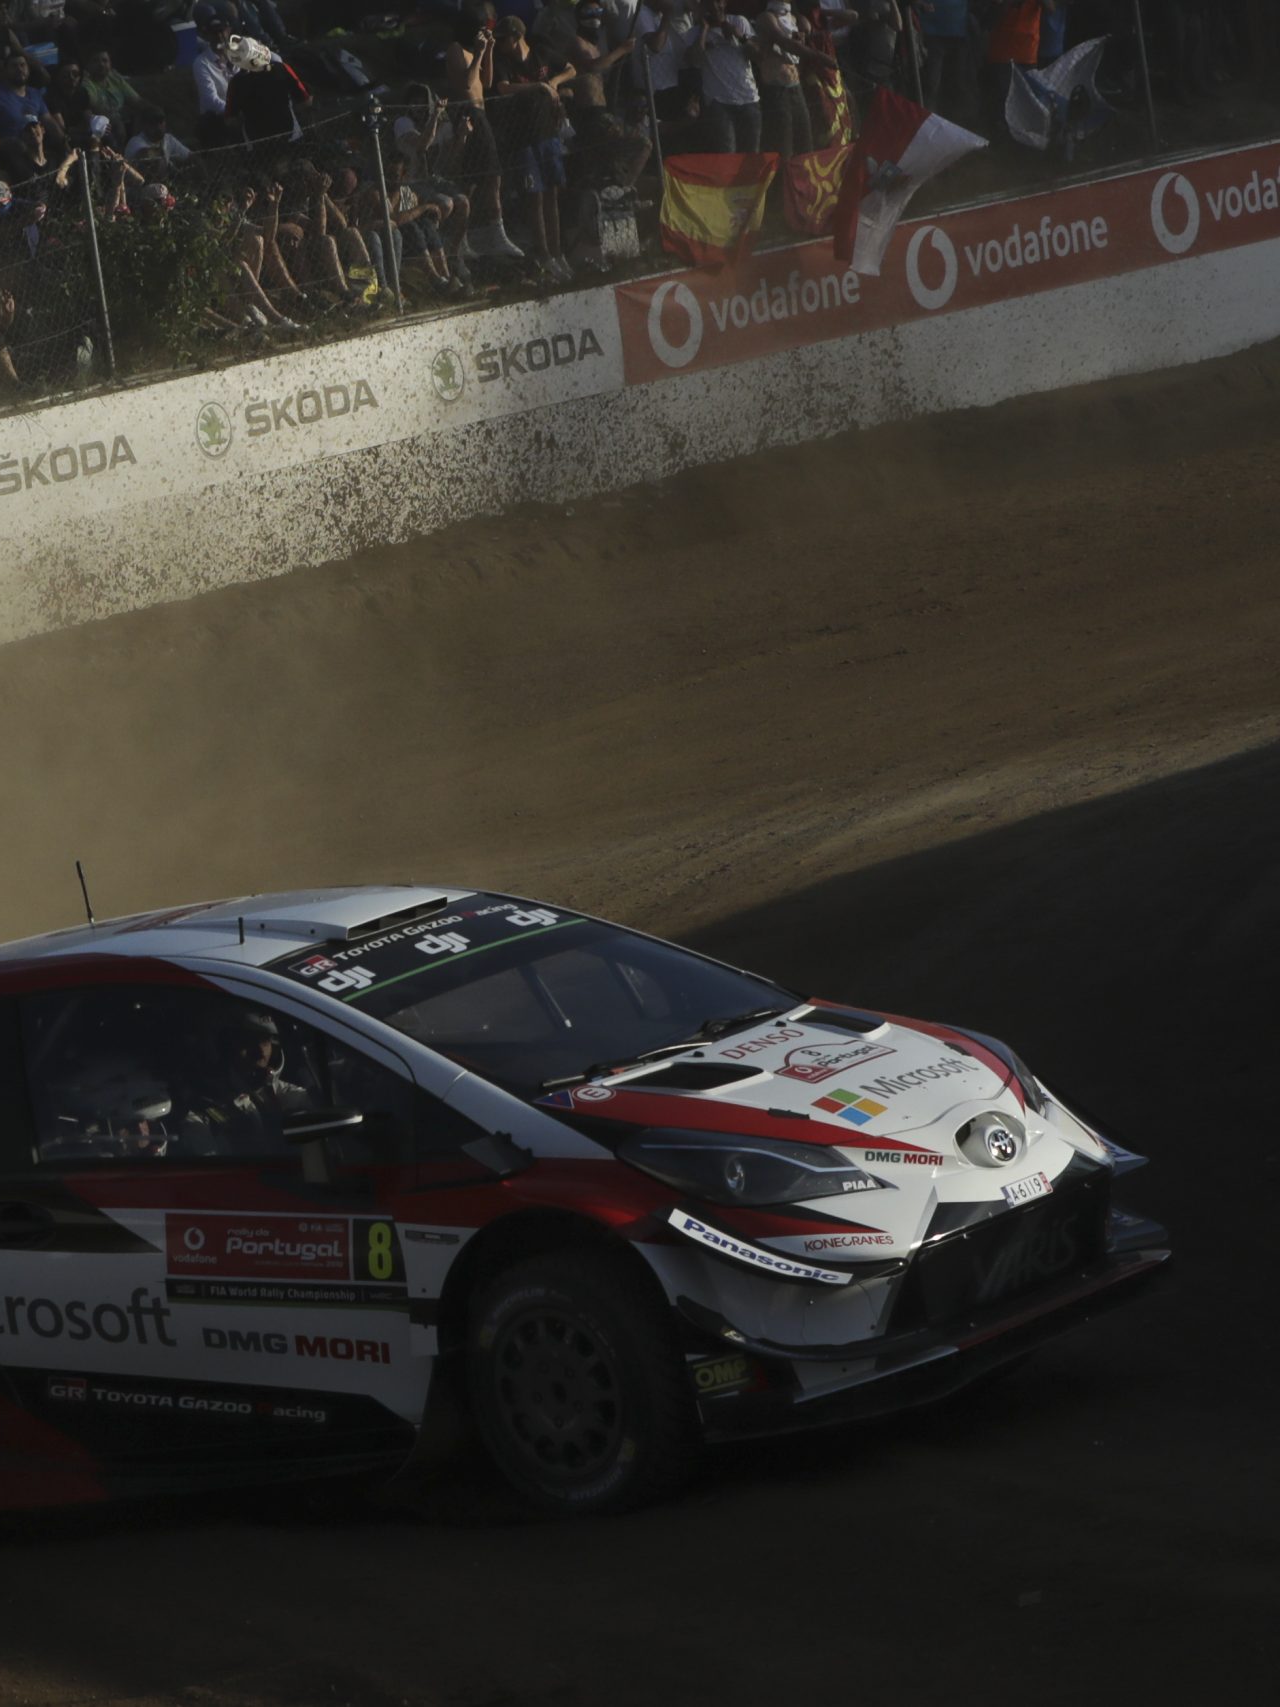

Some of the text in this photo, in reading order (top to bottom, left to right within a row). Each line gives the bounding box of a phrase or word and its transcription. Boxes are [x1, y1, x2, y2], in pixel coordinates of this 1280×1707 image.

[1205, 166, 1280, 222] voda
[963, 215, 1109, 277] vodafone
[708, 270, 860, 332] vodafone
[475, 328, 605, 383] ŠKODA
[244, 379, 380, 437] ŠKODA
[331, 929, 406, 961] TOYOTA
[401, 914, 463, 937] GAZOO
[719, 1028, 805, 1061] DENSO
[859, 1054, 980, 1101] Microsoft
[864, 1150, 944, 1166] DMG MORI
[842, 1179, 877, 1192] PIAA
[172, 1253, 218, 1266] vodafone
[225, 1238, 344, 1261] Portugal
[368, 1221, 393, 1280] 8
[682, 1217, 841, 1282] Panasonic
[803, 1234, 895, 1253] KONECRANES
[210, 1284, 226, 1298] FIA
[228, 1285, 258, 1299] World
[260, 1286, 285, 1302] Rally
[286, 1288, 357, 1304] Championship
[202, 1326, 392, 1365] DMG MORI
[695, 1359, 748, 1388] OMP
[50, 1384, 84, 1400] GR
[92, 1388, 174, 1408] TOYOTA
[177, 1396, 254, 1415] GAZOO
